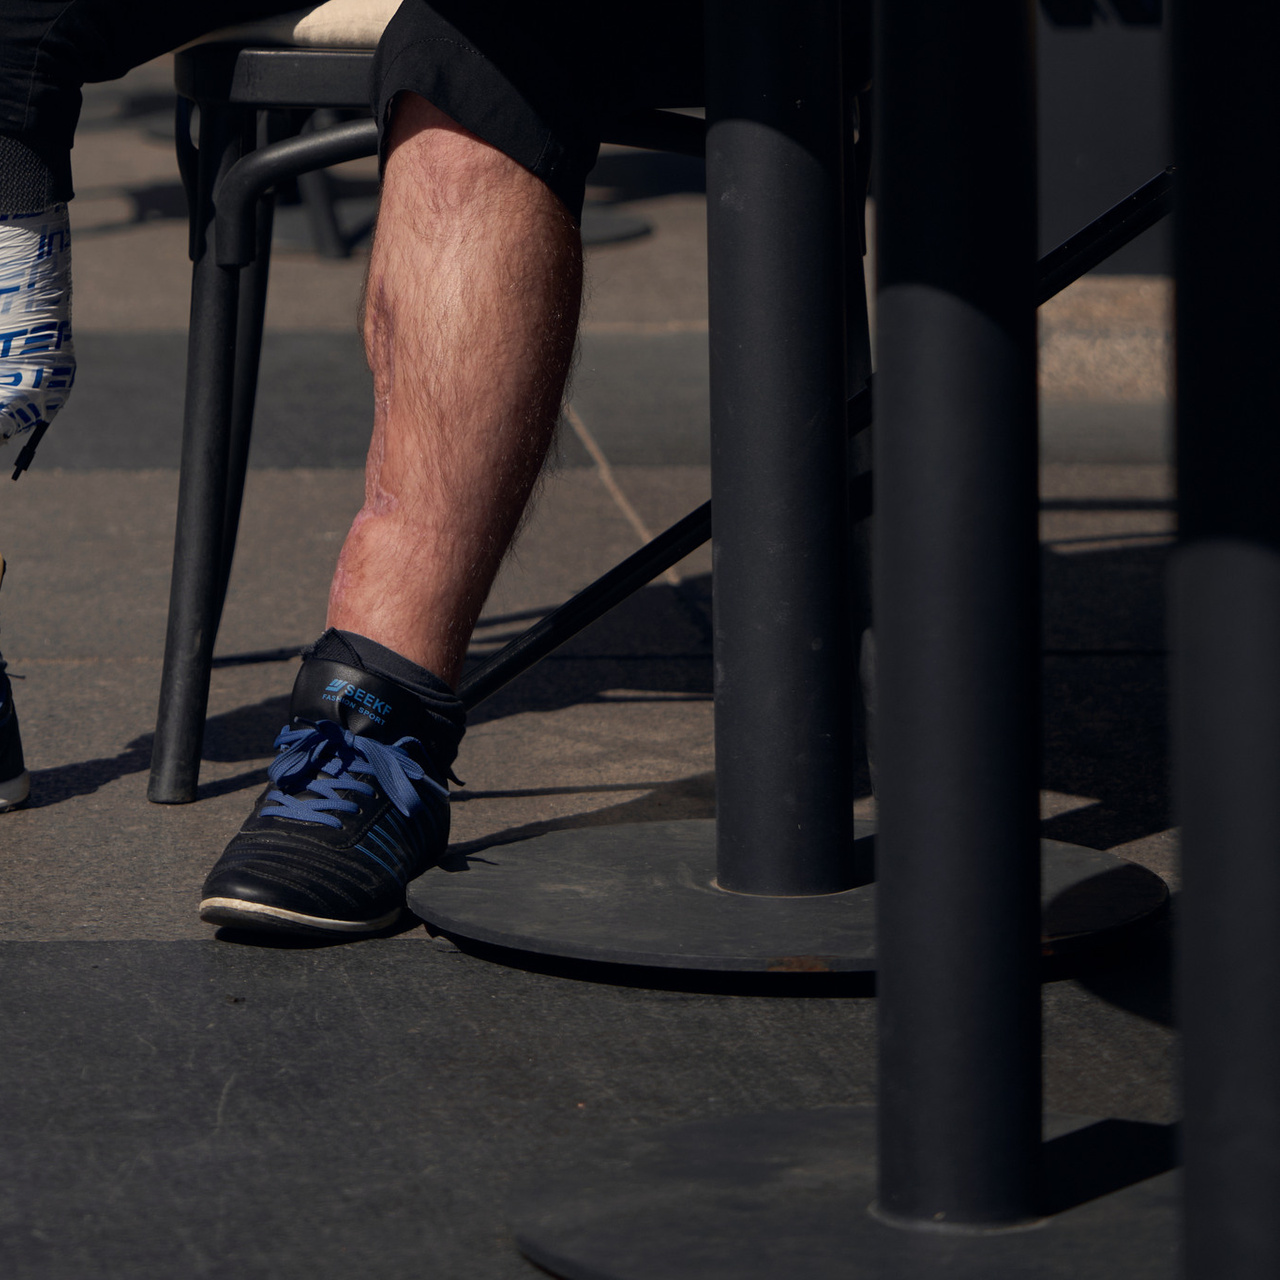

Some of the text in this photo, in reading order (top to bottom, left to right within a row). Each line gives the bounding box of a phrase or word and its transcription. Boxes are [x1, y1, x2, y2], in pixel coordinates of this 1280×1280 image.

[322, 693, 386, 726] FASHION SPORT
[344, 684, 393, 716] SEEKF
